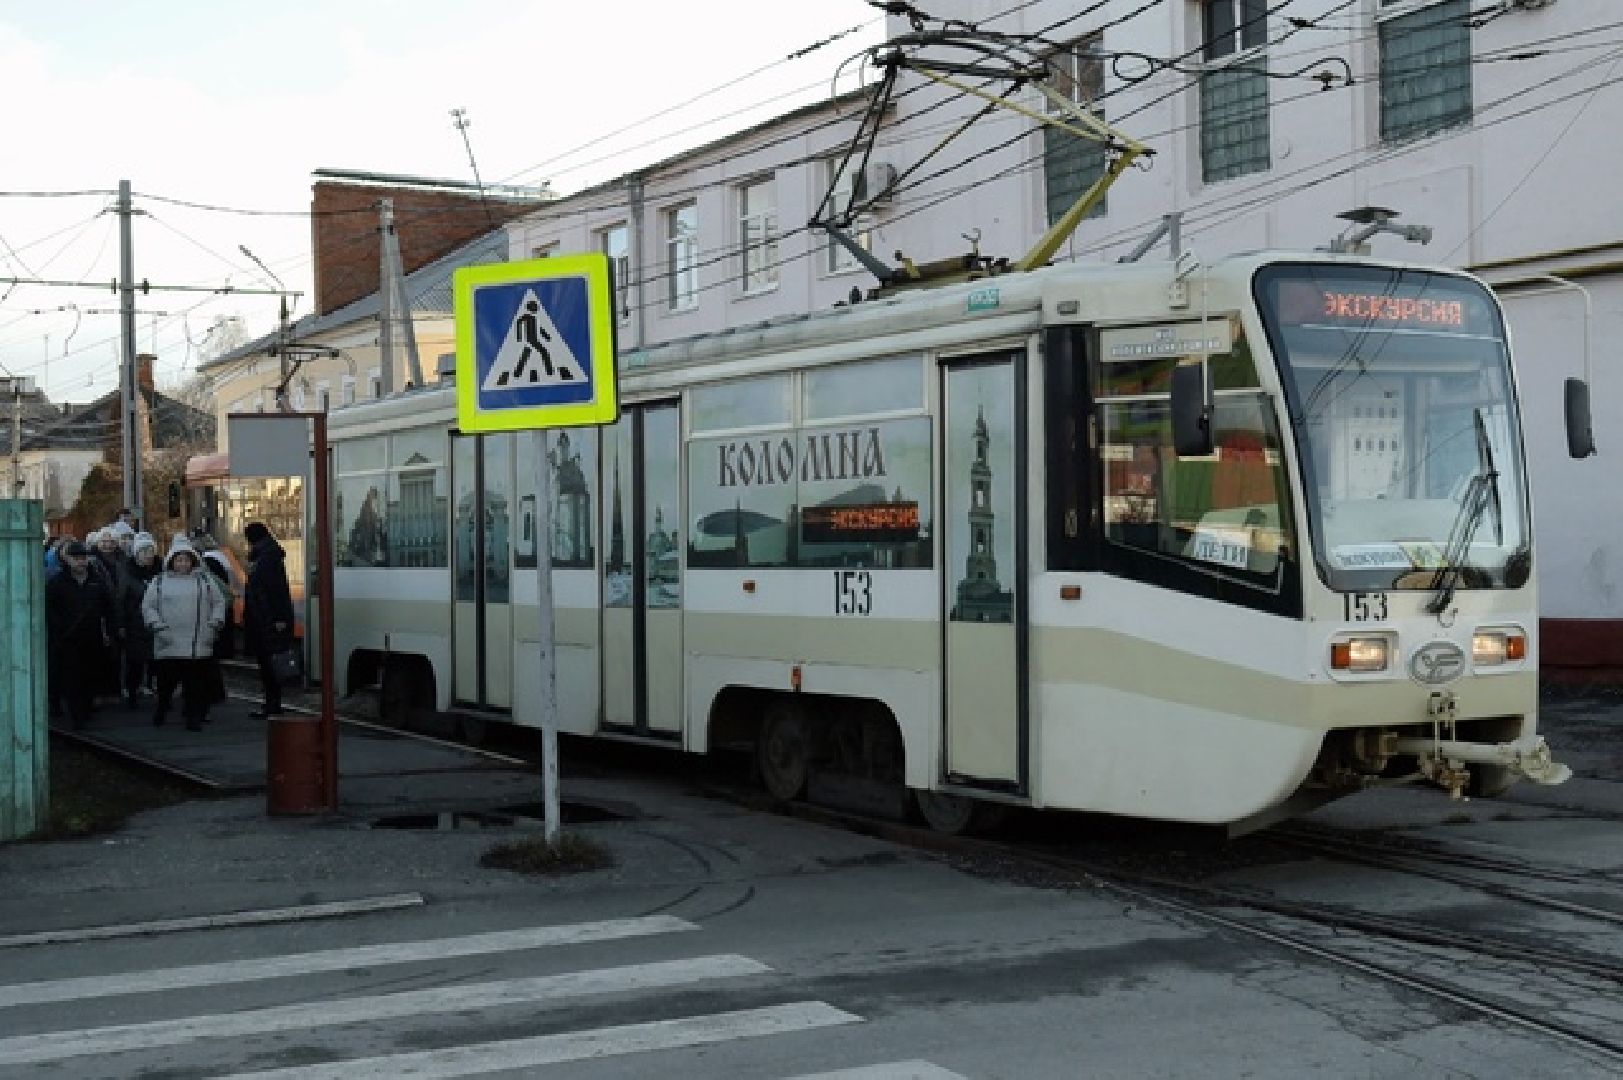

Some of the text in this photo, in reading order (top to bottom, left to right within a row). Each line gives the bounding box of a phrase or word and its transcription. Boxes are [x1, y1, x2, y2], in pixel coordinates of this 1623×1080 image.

[1323, 290, 1462, 325] ЭКСКУРСИЯ
[718, 427, 887, 487] КОЛОМНА
[834, 571, 873, 617] 153
[1343, 592, 1388, 622] 153
